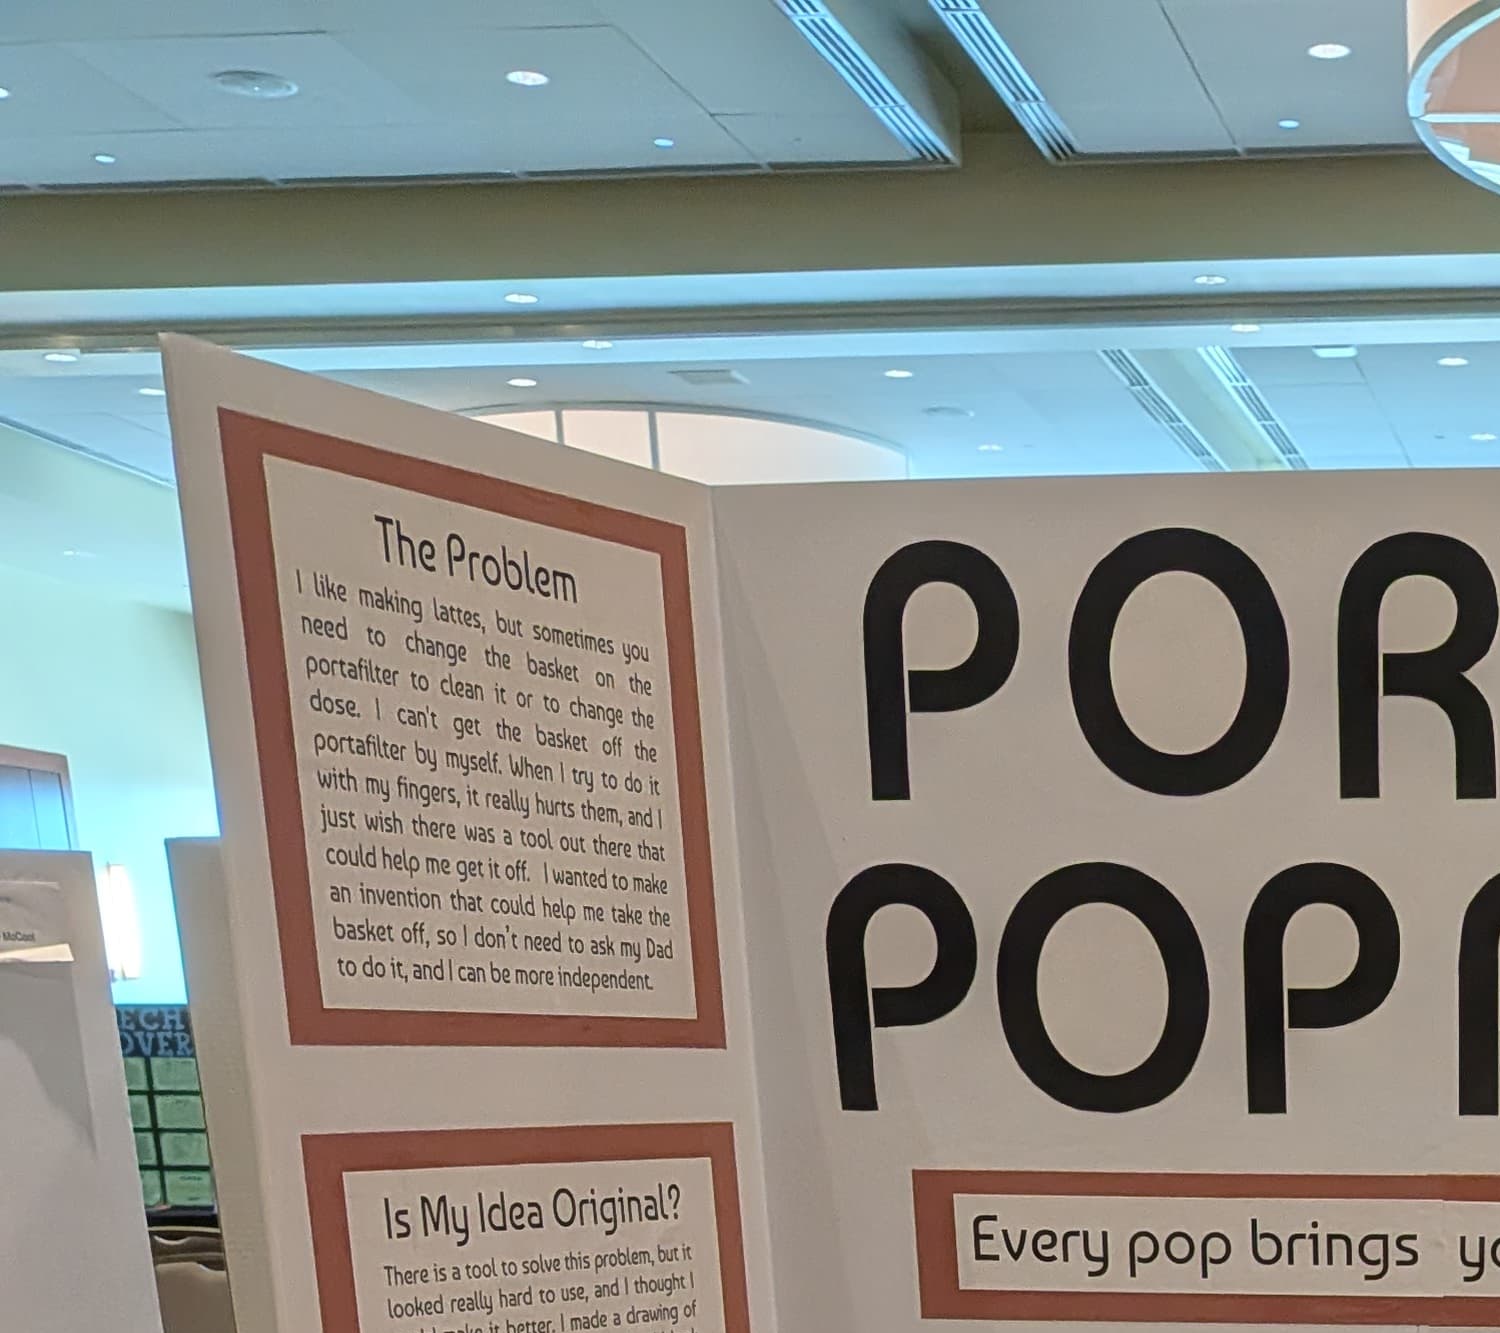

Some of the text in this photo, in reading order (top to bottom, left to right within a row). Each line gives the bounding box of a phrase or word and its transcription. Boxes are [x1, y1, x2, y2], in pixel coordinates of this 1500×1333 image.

[373, 513, 578, 605] The Problem
[295, 568, 650, 666] I like making lattes, but sometimes you
[383, 1182, 681, 1248] Is My Idea Original?
[972, 1214, 1110, 1278] Every
[1128, 1230, 1232, 1280] pop
[1250, 1217, 1419, 1282] brings
[383, 1242, 693, 1288] There is a tool to solve this problem, but it
